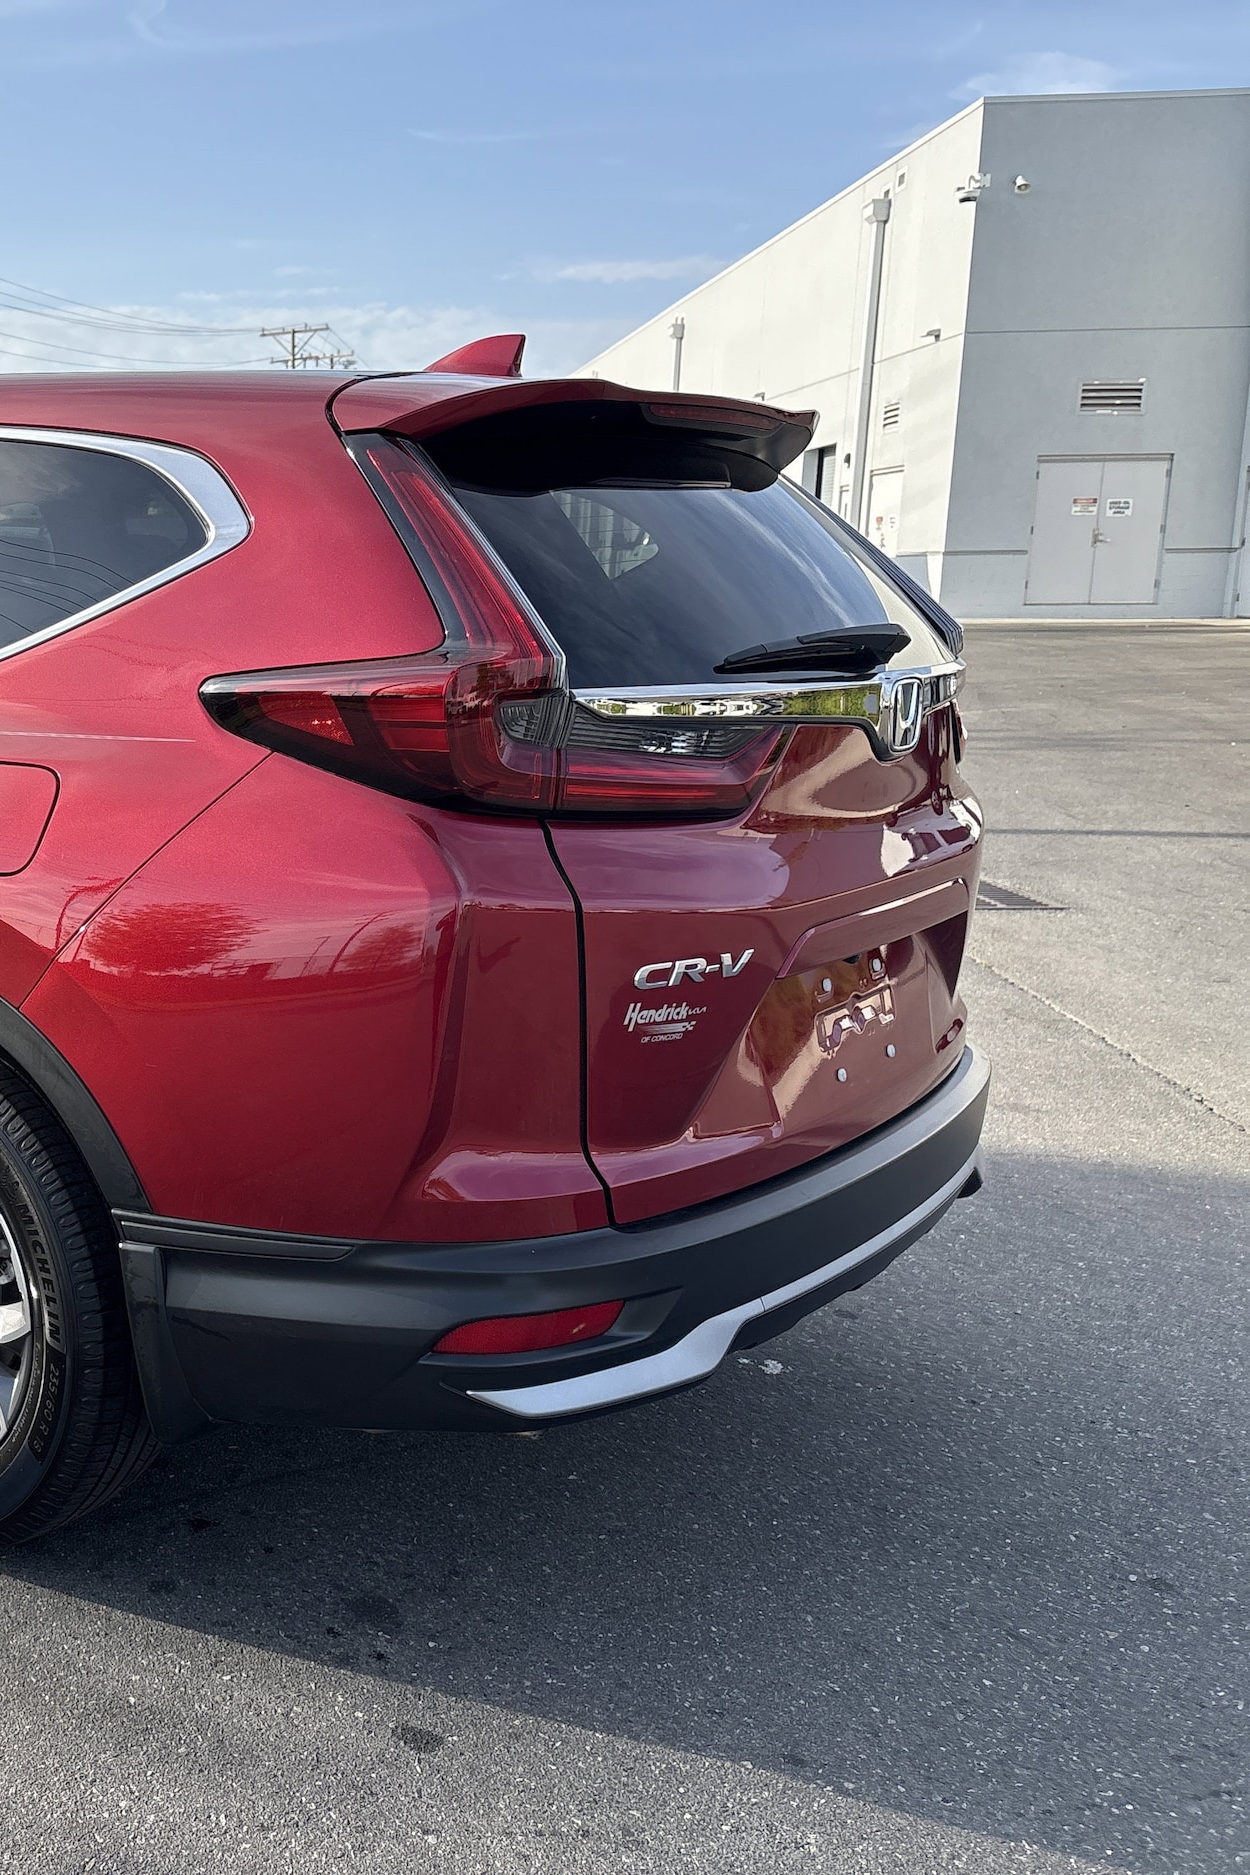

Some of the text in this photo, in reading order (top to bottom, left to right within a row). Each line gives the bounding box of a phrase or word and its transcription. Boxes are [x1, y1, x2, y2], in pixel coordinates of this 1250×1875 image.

[634, 948, 755, 990] CR-V
[623, 1002, 690, 1032] Hendrick
[640, 1032, 683, 1044] OF CONCORD
[16, 1203, 61, 1345] MICHELIN
